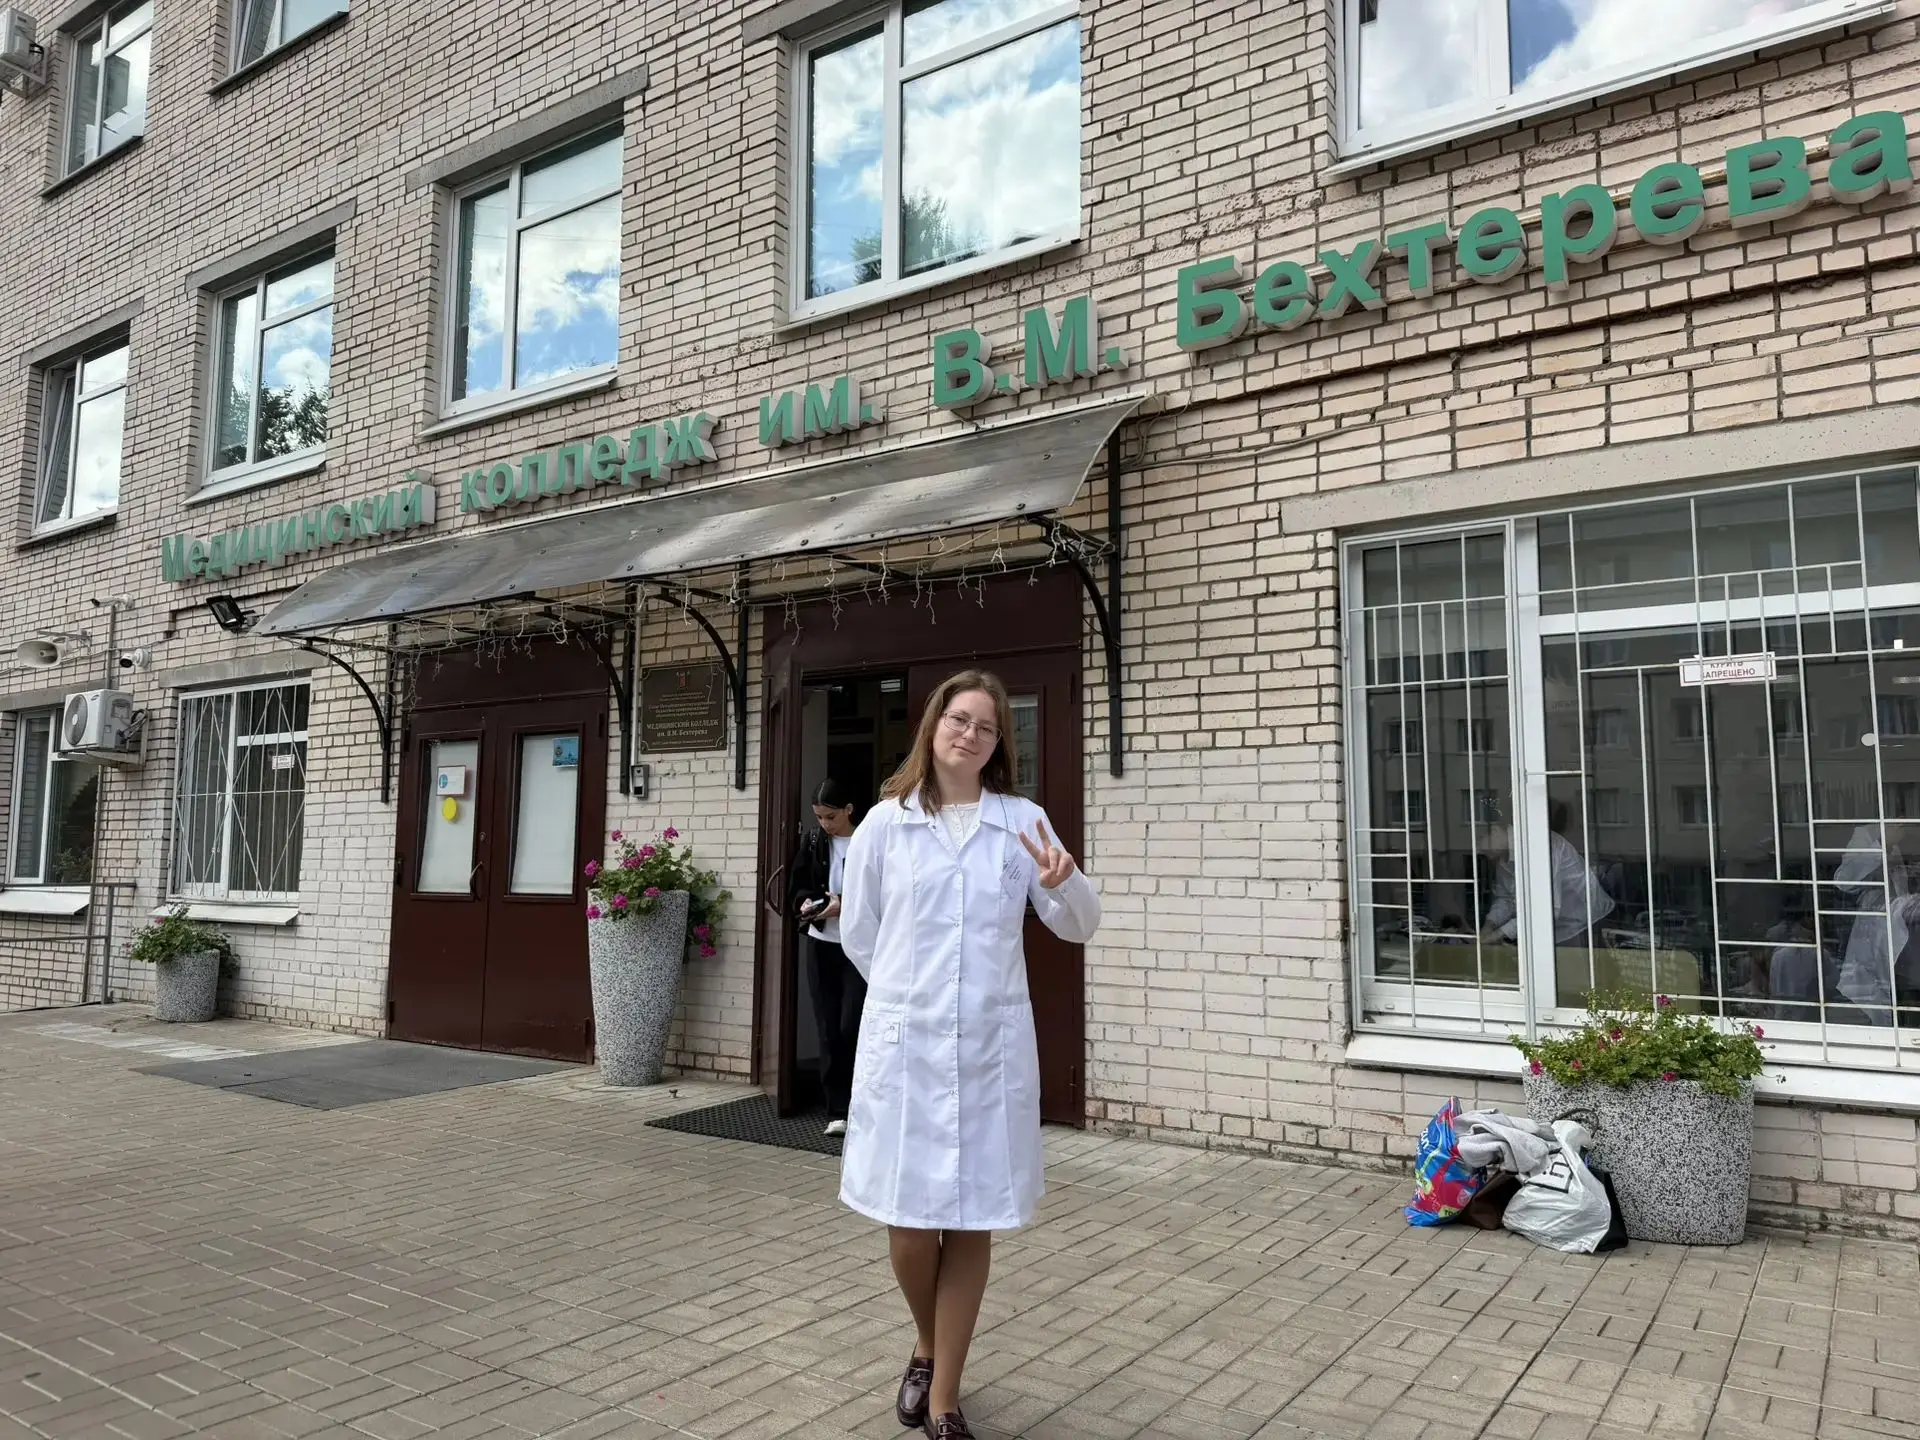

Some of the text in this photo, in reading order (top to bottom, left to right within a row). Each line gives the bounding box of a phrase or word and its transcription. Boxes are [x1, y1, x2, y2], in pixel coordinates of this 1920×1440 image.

[162, 110, 1914, 582] Медицинский колледж им. В.М. Бехтерева
[1702, 668, 1756, 679] АПРЕЩЕНО
